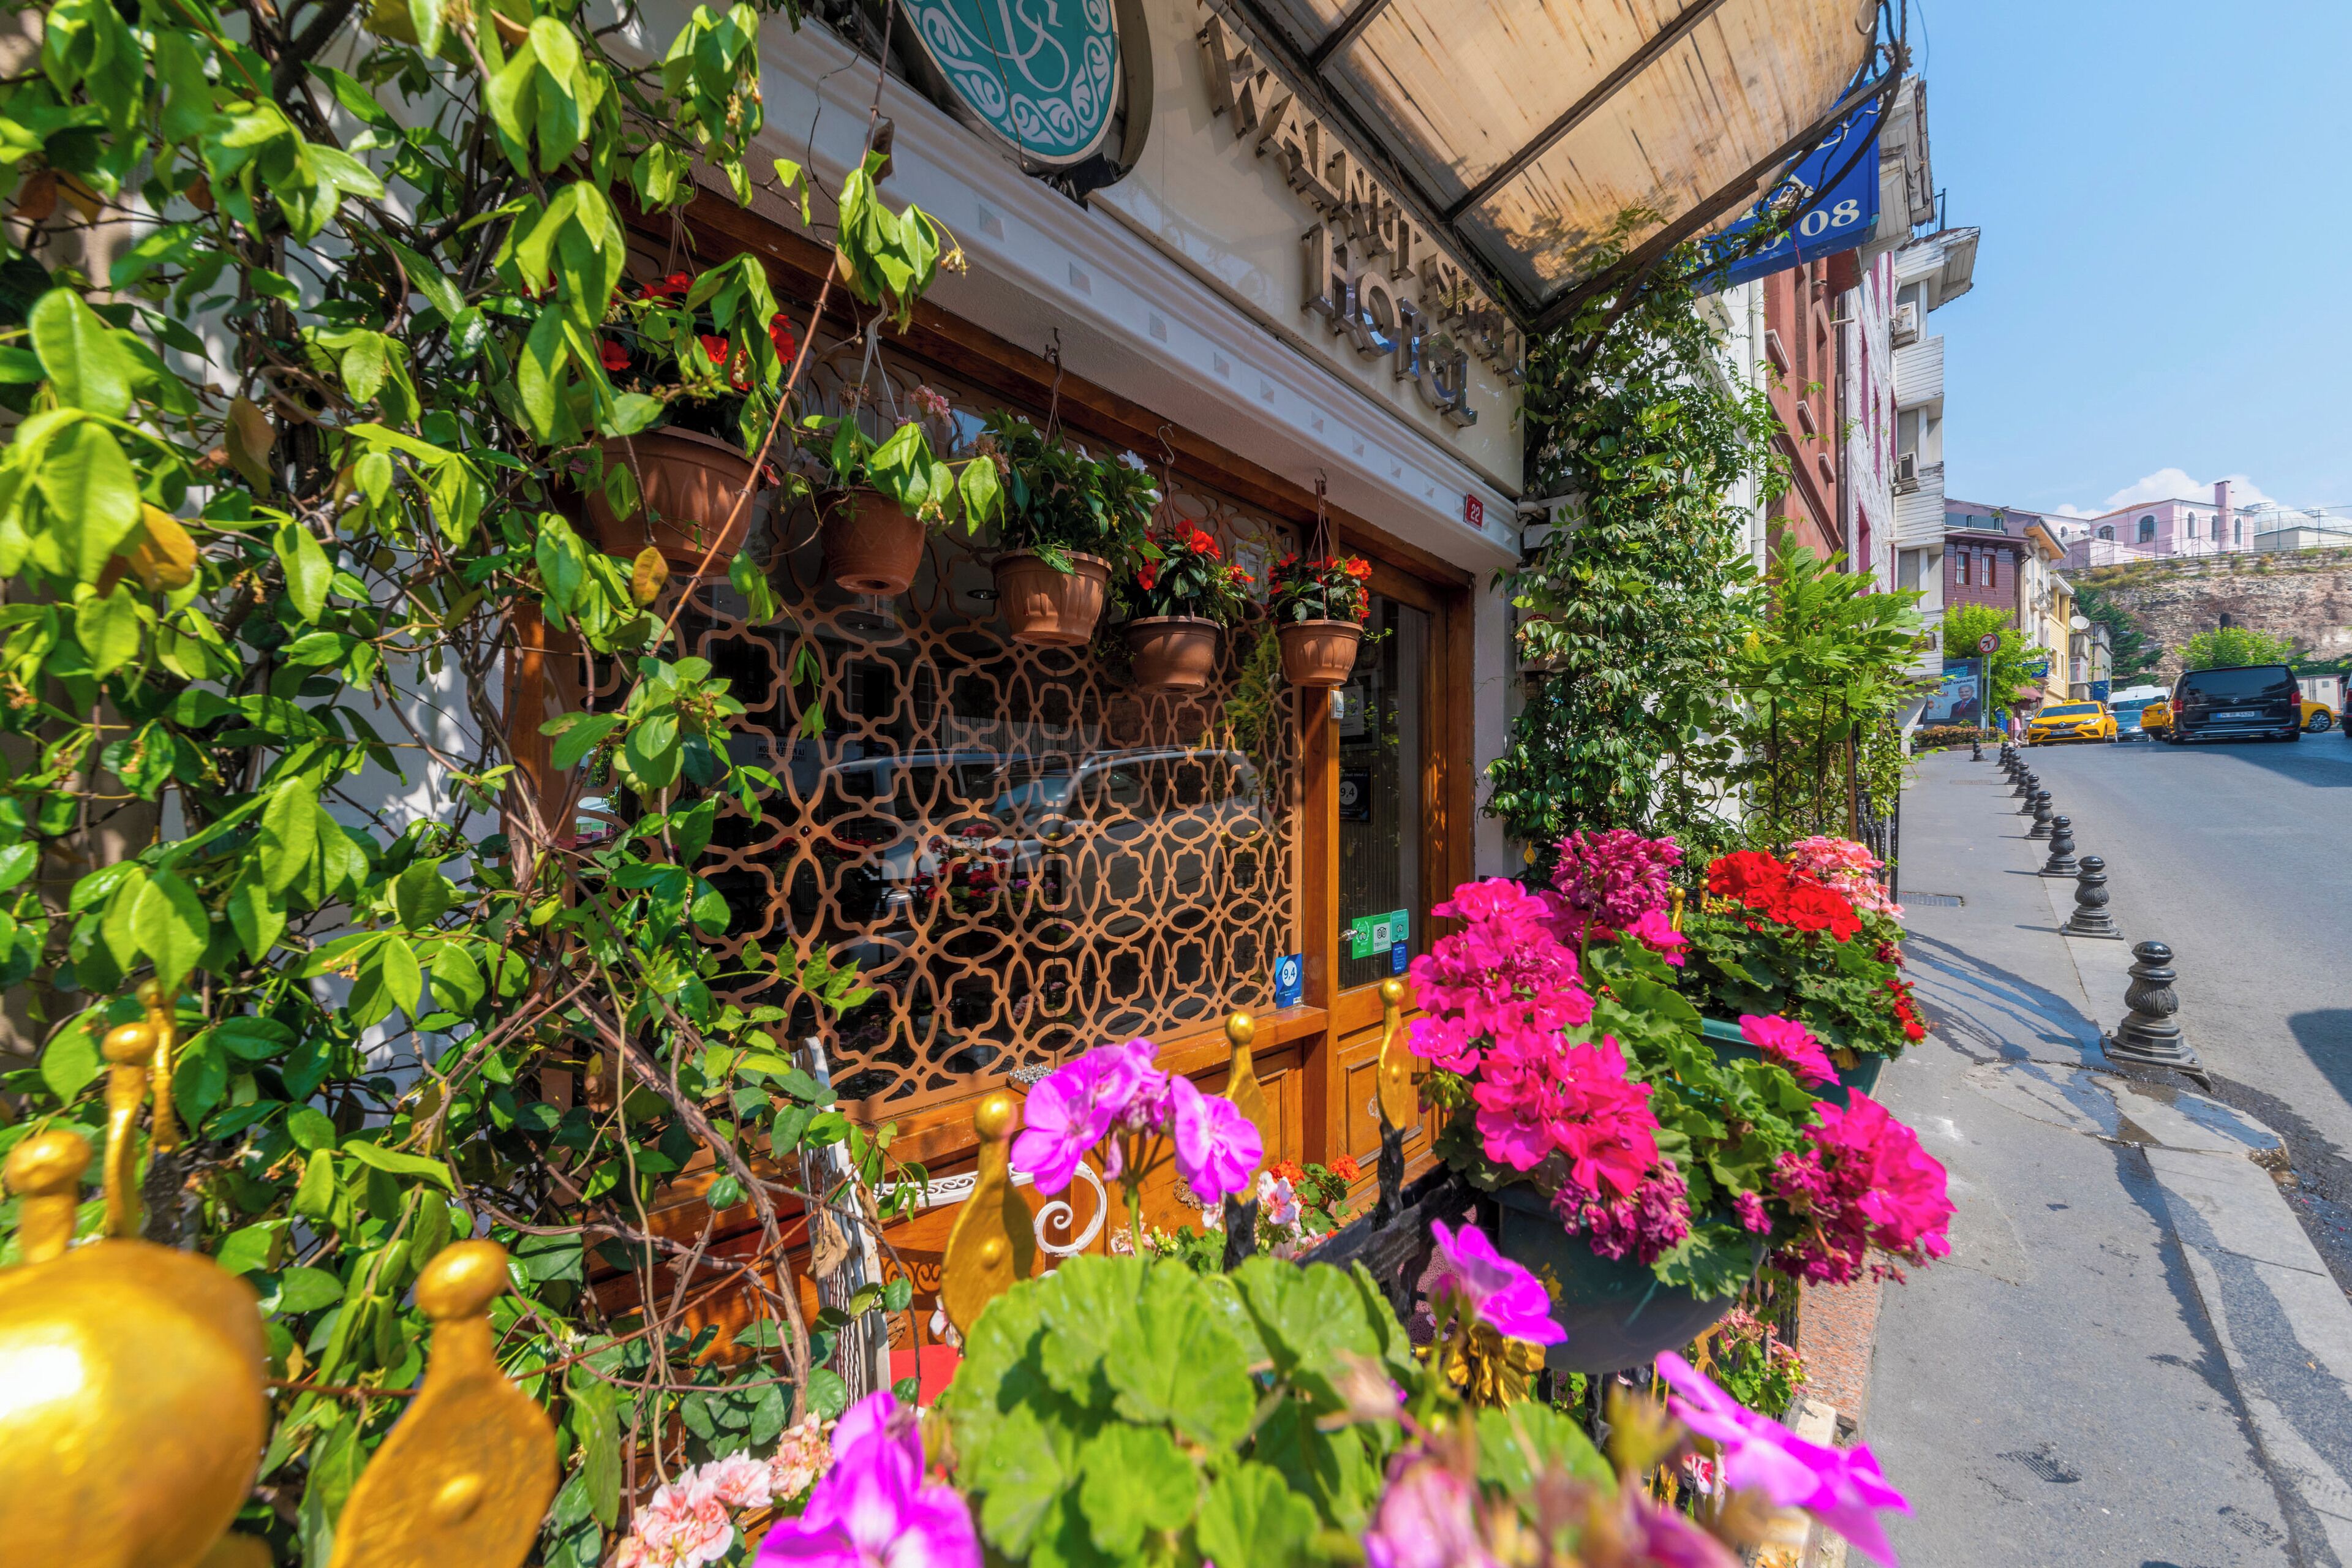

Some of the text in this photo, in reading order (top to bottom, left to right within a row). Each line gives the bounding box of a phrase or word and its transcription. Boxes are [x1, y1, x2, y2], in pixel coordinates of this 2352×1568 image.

[1207, 12, 1422, 280] WALNUT
[1471, 503, 1480, 522] 22
[1284, 967, 1295, 980] 9,4
